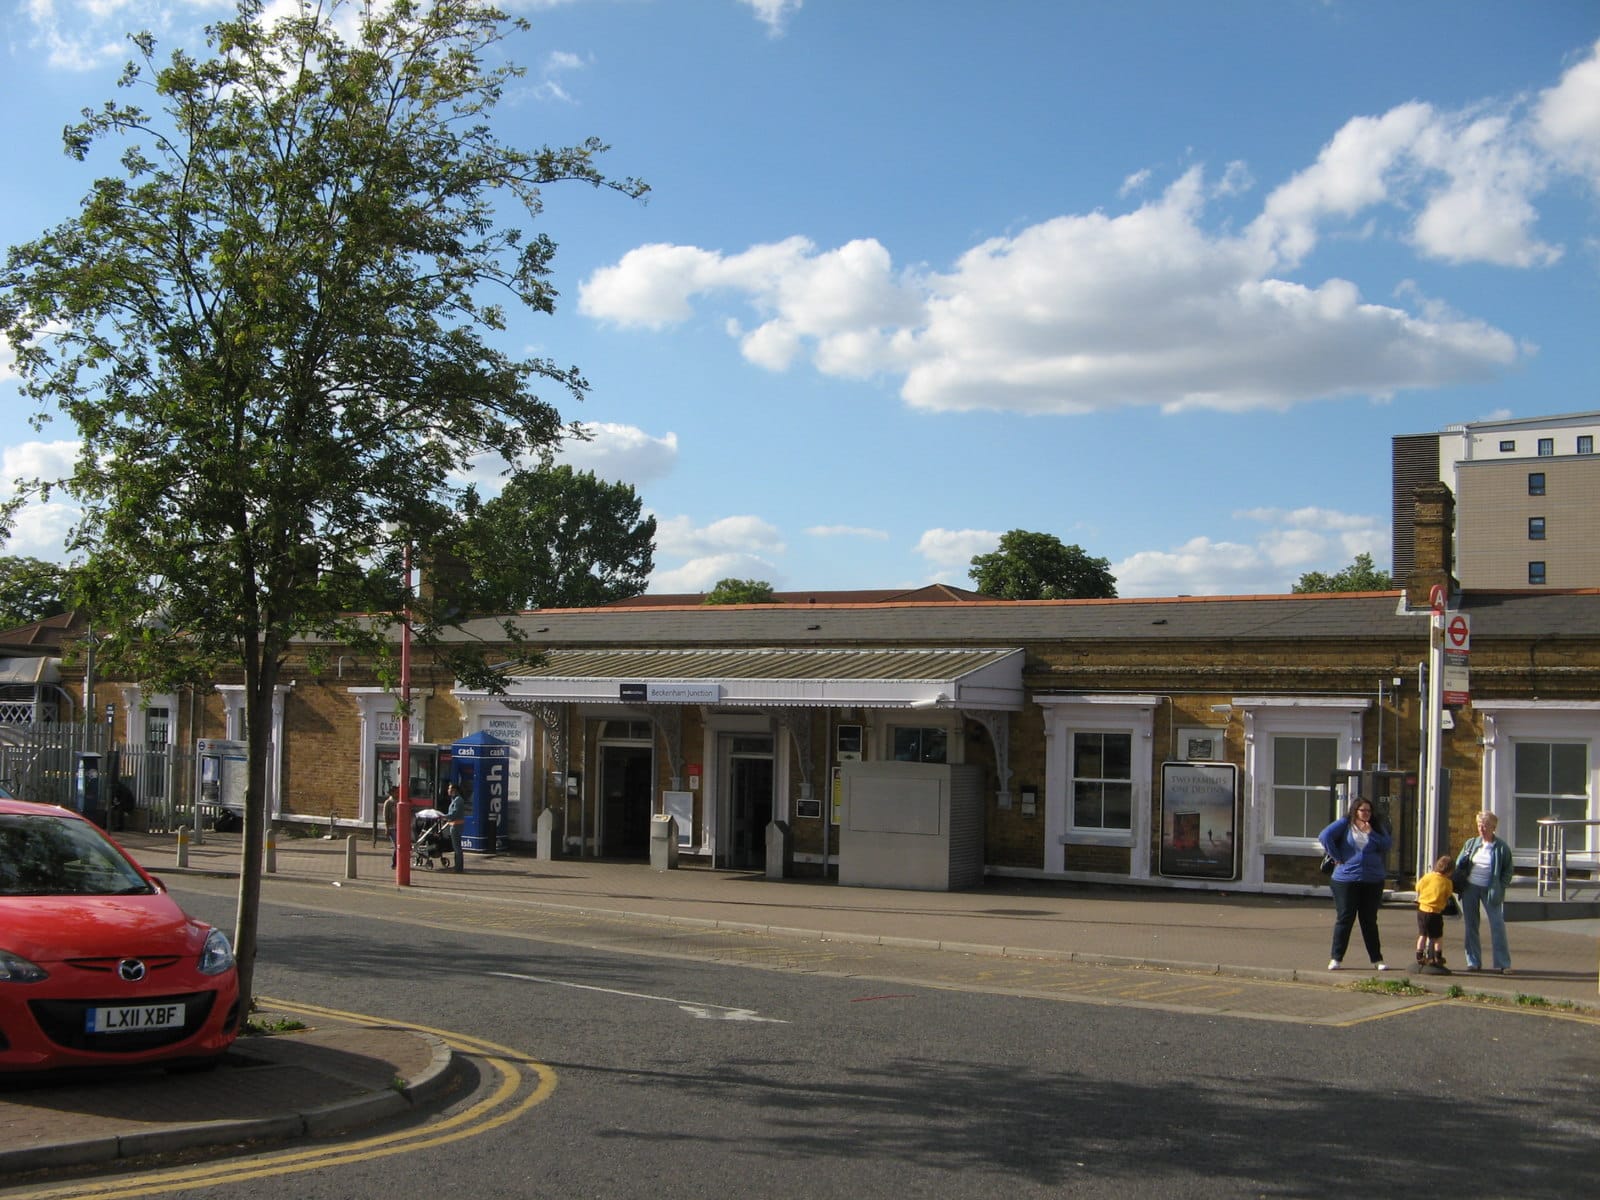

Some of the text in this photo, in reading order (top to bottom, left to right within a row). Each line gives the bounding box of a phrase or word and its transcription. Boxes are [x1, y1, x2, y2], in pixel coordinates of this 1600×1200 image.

[1434, 589, 1444, 607] A
[651, 688, 686, 697] Beckenham
[687, 688, 713, 698] Junction
[489, 720, 518, 729] MORNING
[458, 747, 475, 756] cash
[105, 1006, 177, 1028] LX11 XBF
